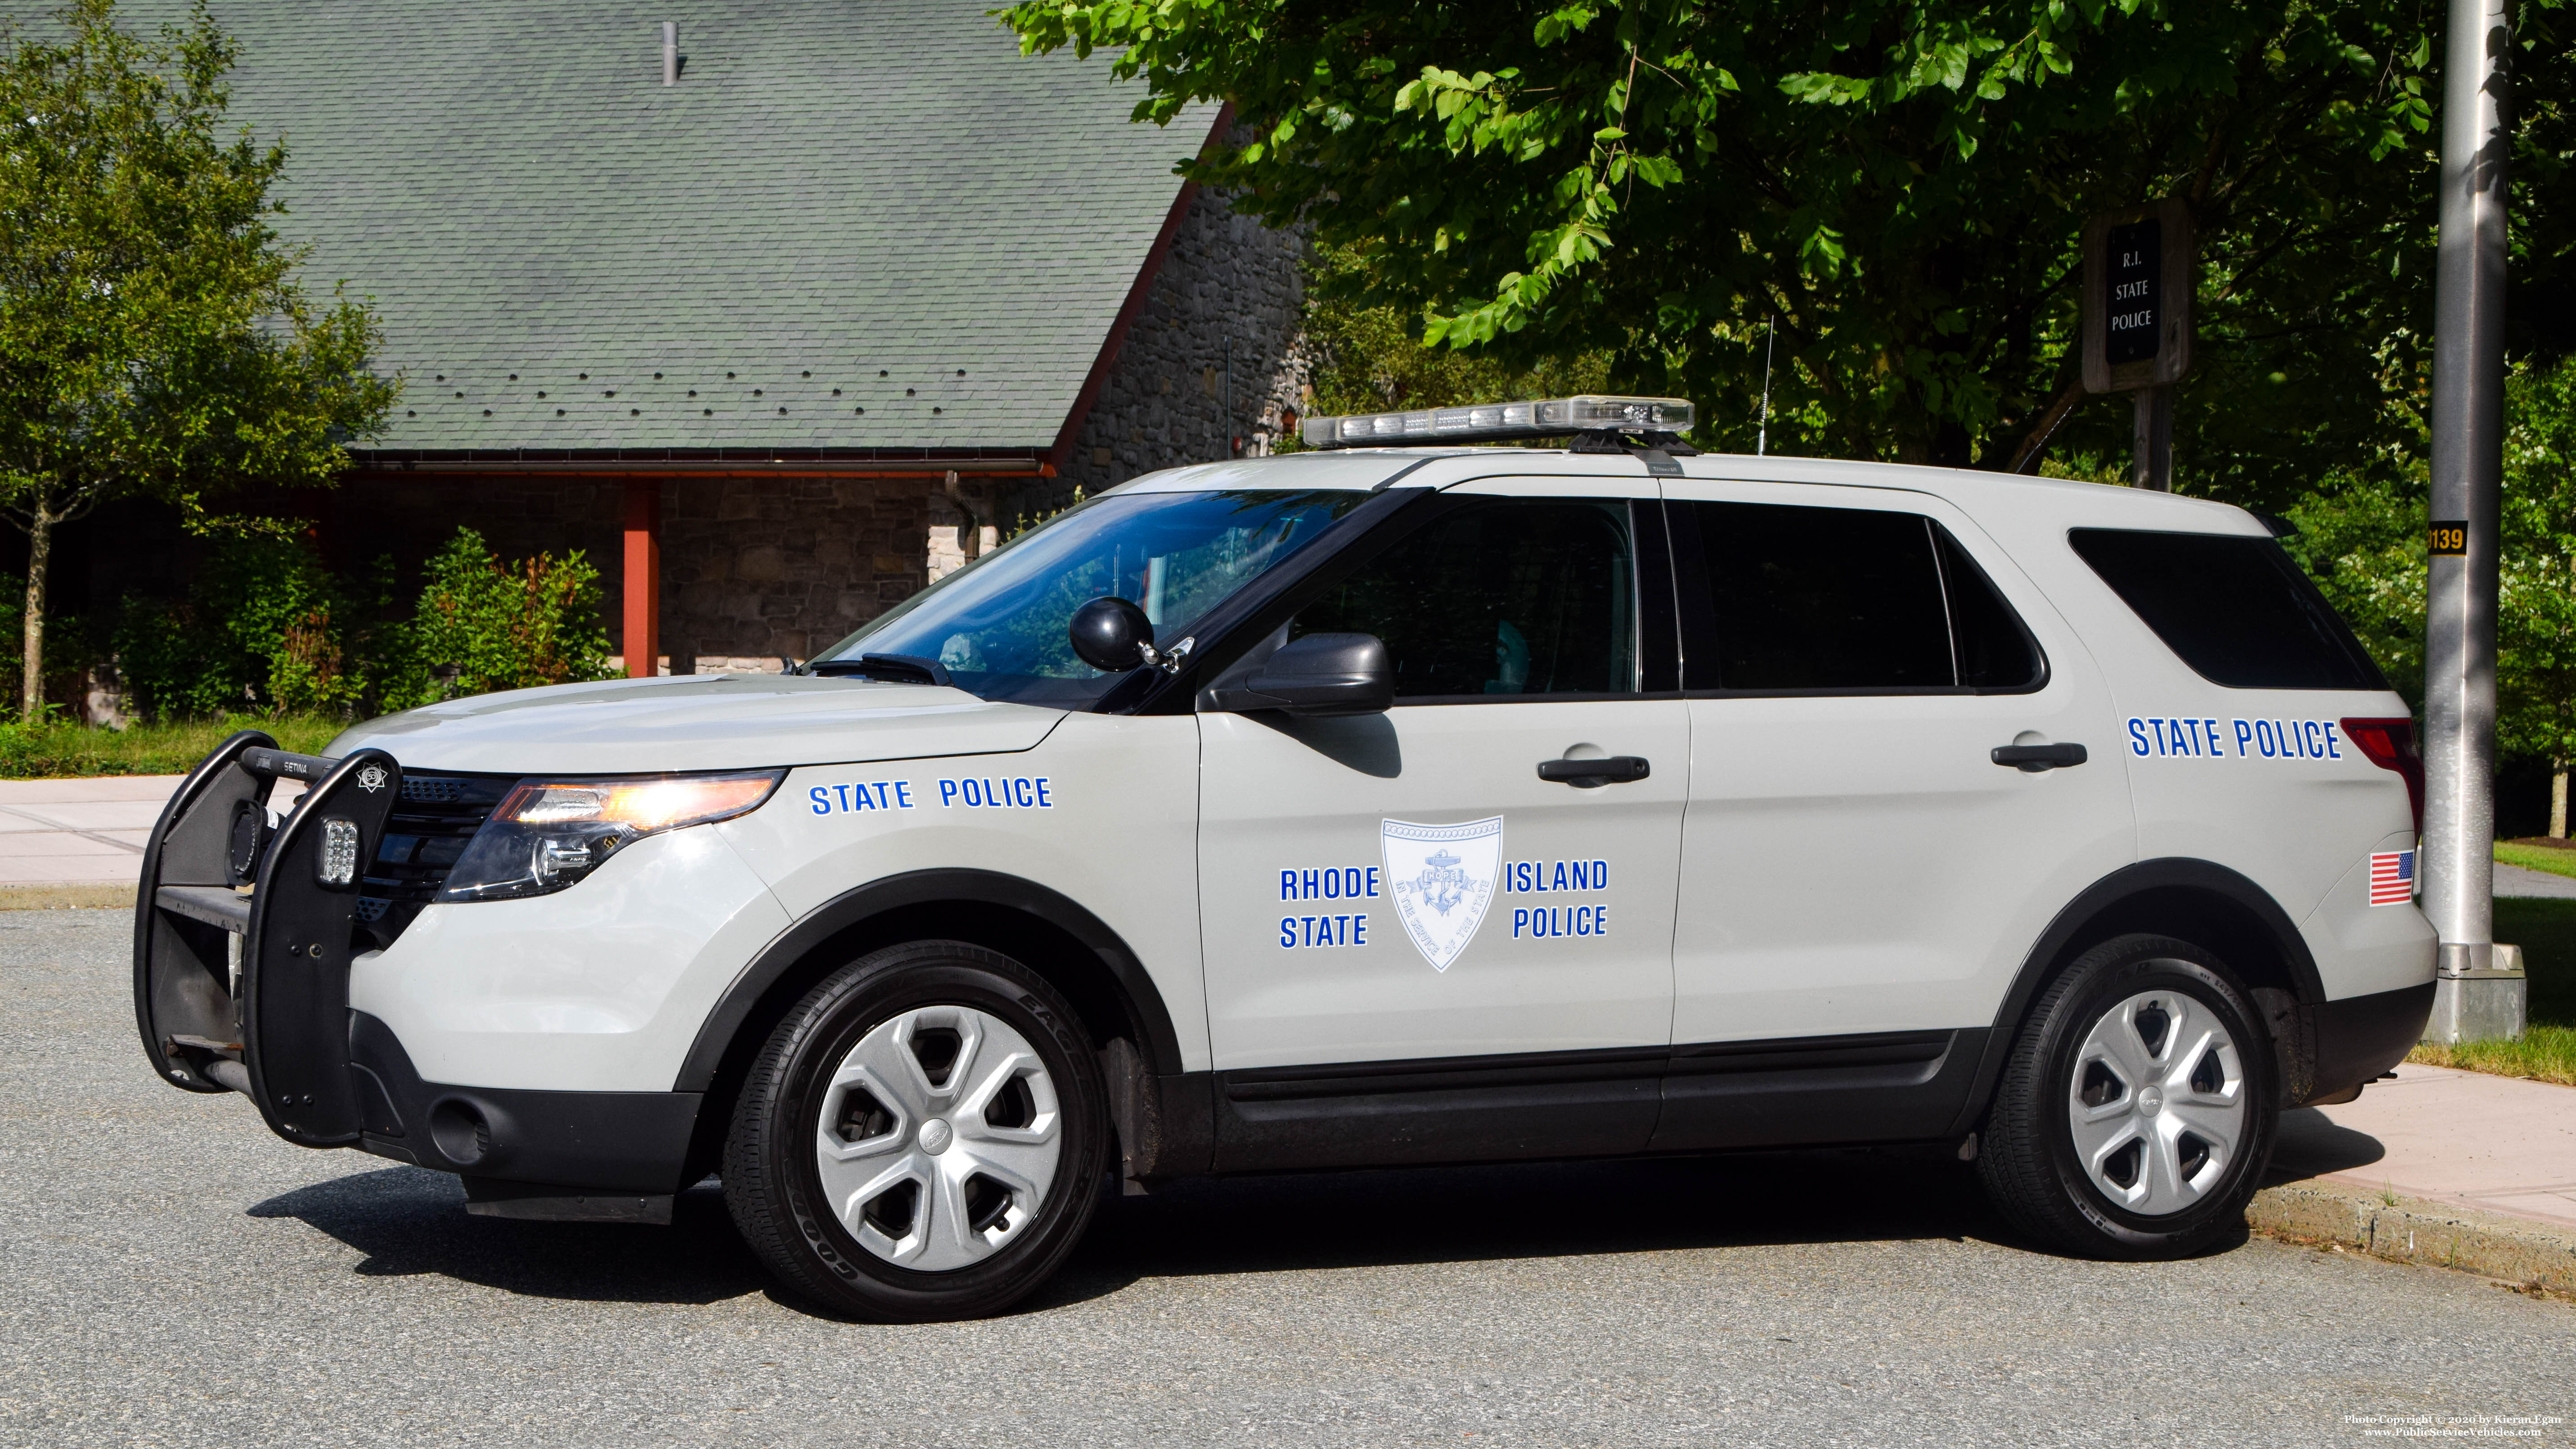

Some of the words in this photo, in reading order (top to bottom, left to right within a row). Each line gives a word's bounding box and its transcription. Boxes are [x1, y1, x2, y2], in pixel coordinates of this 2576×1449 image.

[2123, 250, 2141, 267] R.I.
[2116, 280, 2148, 300] STATE
[2112, 310, 2151, 331] POLICE
[2127, 717, 2225, 758] STATE
[2231, 718, 2343, 761] POLICE
[284, 761, 307, 774] SETINA
[808, 779, 916, 817] STATE
[937, 777, 1054, 810] POLICE
[1279, 865, 1380, 902] RHODE
[1505, 859, 1608, 894] ISLAND
[1429, 871, 1456, 880] HOPE
[1279, 913, 1368, 949] STATE
[1512, 904, 1608, 939] POLICE
[1395, 879, 1407, 894] IN
[1401, 896, 1415, 918] THE
[1410, 919, 1440, 956] SERVICE
[1444, 939, 1457, 955] OF
[1456, 917, 1474, 937] THE
[1470, 879, 1490, 915] STATE
[1017, 993, 1093, 1100] EAGLE
